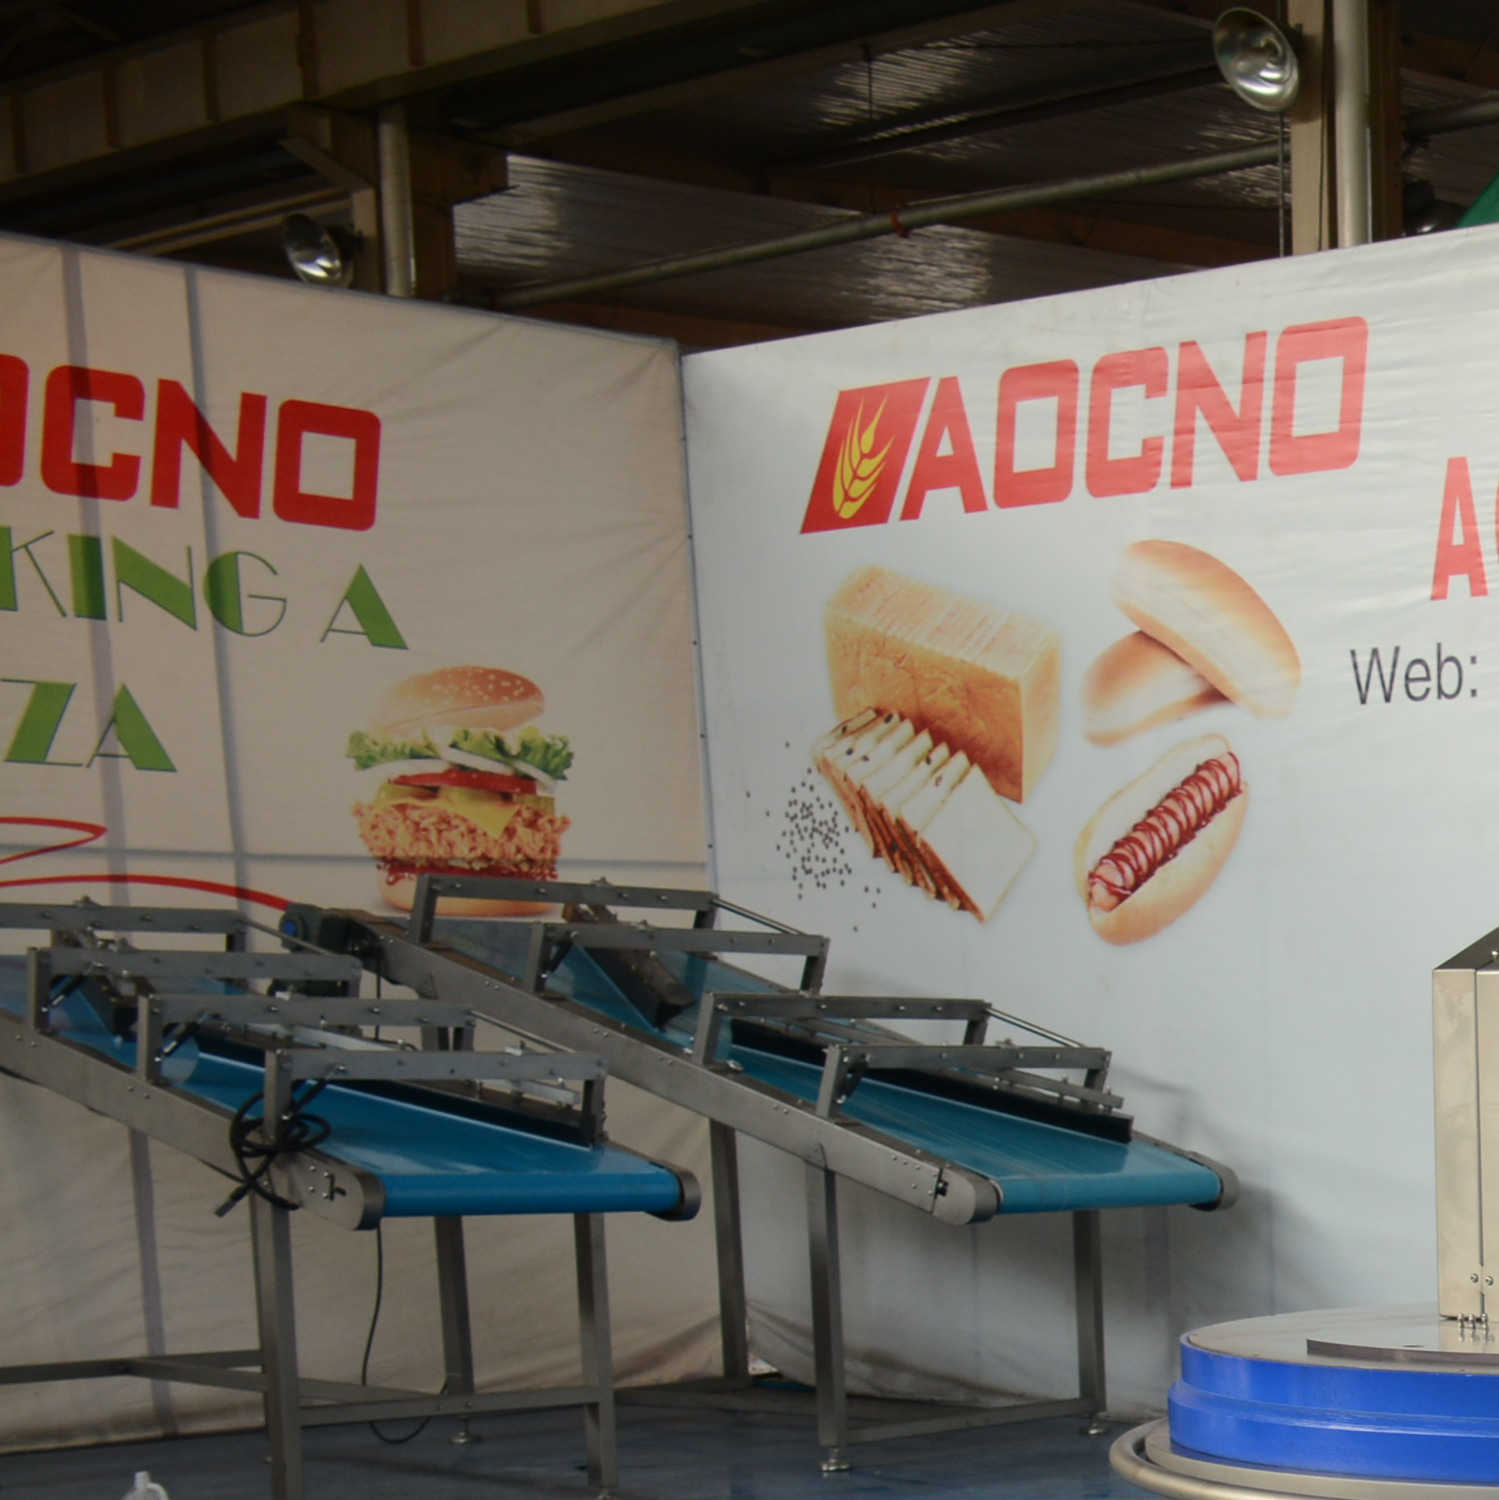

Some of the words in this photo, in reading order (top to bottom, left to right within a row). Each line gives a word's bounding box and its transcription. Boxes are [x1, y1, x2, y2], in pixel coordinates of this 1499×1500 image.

[900, 317, 1368, 520] AOCNO
[320, 564, 409, 650] A
[1349, 640, 1479, 706] Web:
